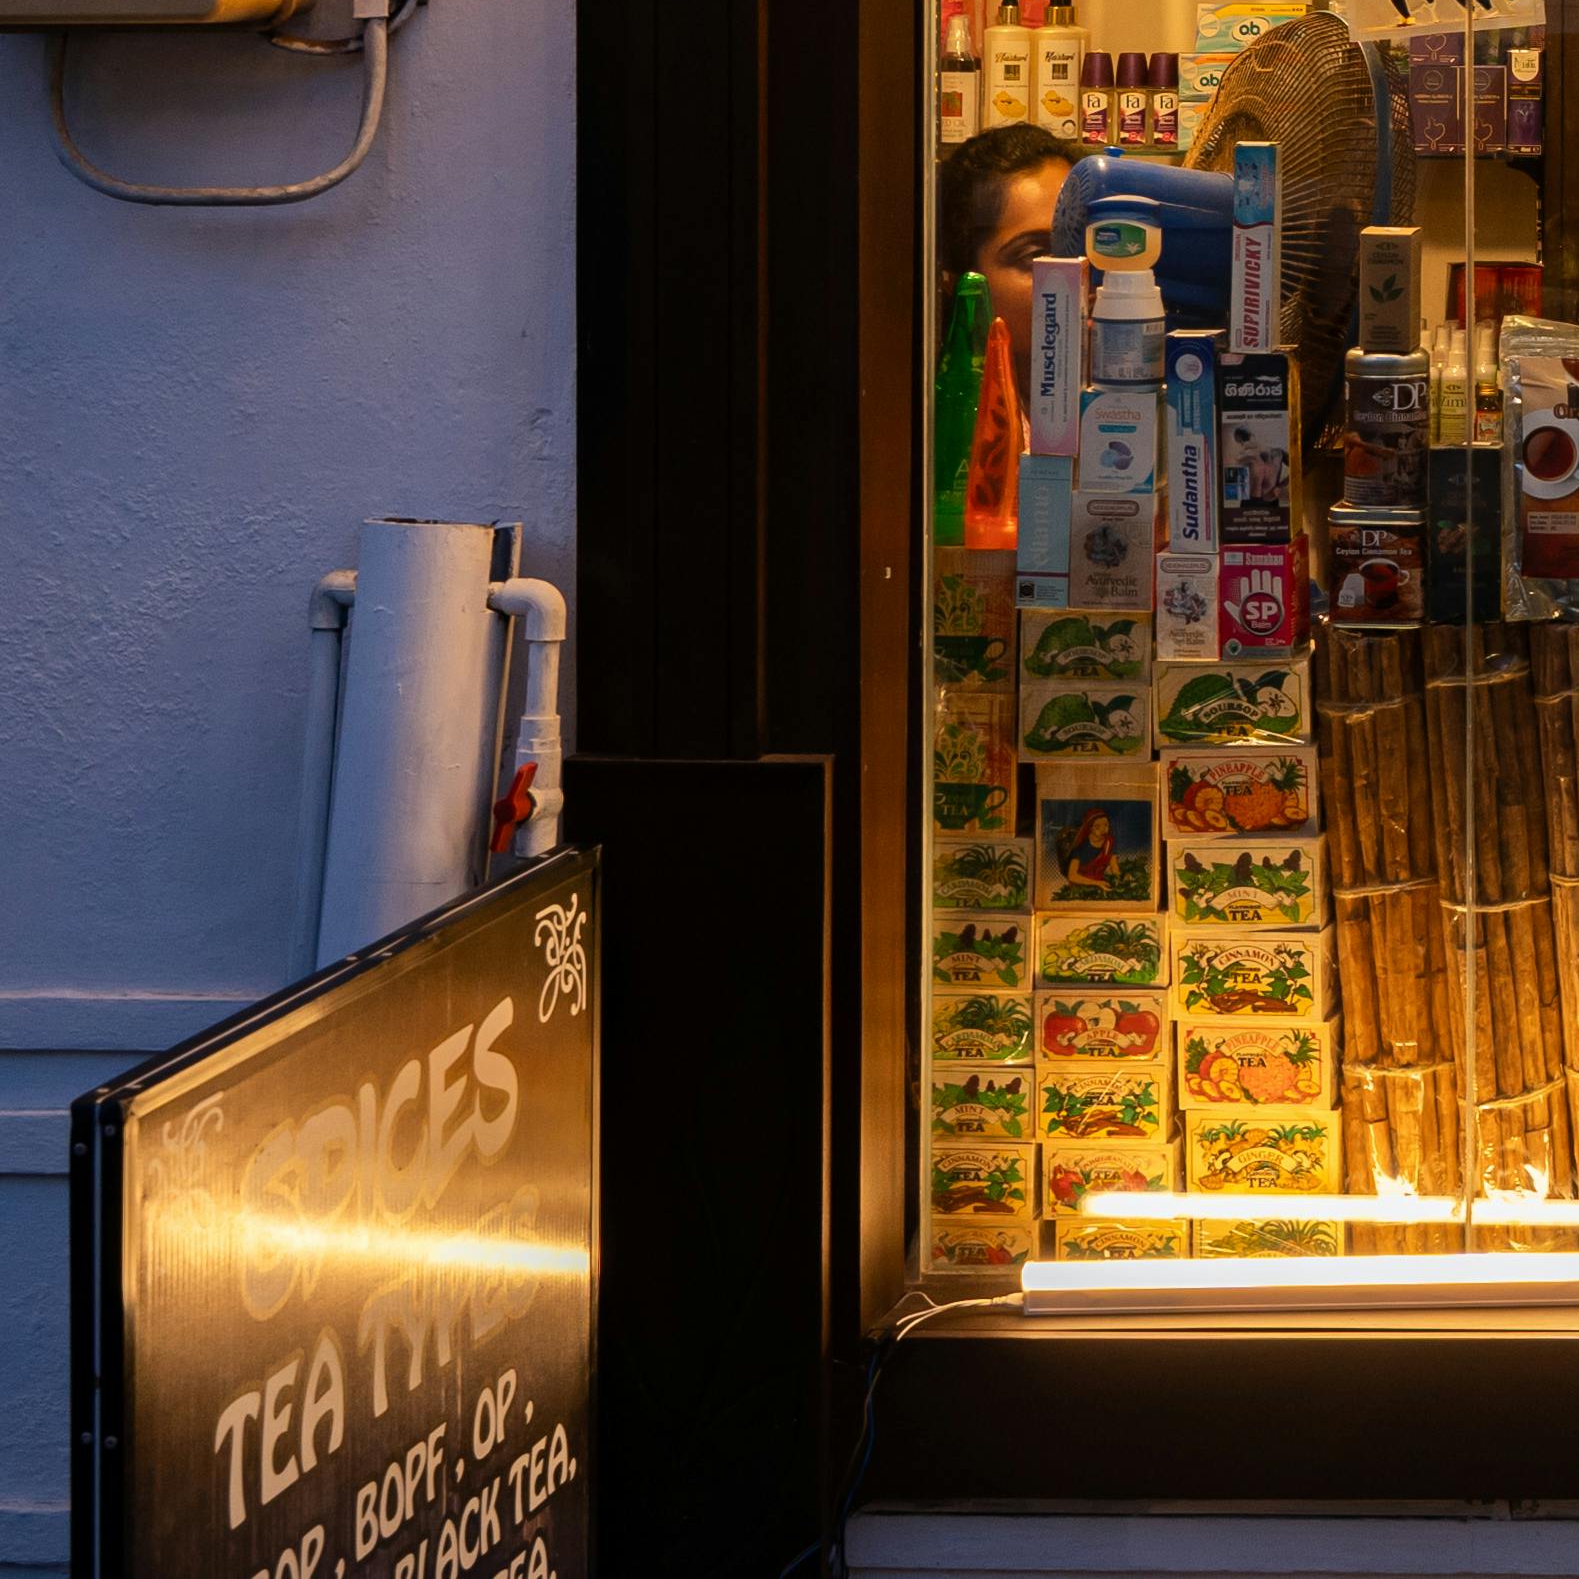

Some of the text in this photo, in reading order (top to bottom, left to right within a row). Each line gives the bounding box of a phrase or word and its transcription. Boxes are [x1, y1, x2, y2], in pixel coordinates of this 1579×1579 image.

[1087, 95, 1101, 109] Fa
[1126, 95, 1140, 109] Fa
[1159, 95, 1173, 109] Fa
[1242, 236, 1262, 348] SUPIRIVICKY
[1040, 292, 1060, 398] Musclegard
[1392, 382, 1427, 411] DP
[1095, 407, 1141, 421] Swastha
[1181, 443, 1200, 541] Sudantha
[1362, 529, 1388, 547] DP
[1111, 586, 1138, 597] Balm
[1246, 601, 1278, 620] SP
[1072, 666, 1099, 677] TEA
[1203, 703, 1258, 720] SOURSOP
[1216, 726, 1248, 737] TEA
[1072, 742, 1099, 753] TEA
[1209, 763, 1264, 783] PINEAPPLE
[1223, 784, 1253, 797] TEA
[940, 804, 968, 815] TEA
[1226, 889, 1259, 901] MINT
[1229, 909, 1263, 922] TEA
[951, 954, 980, 964] MINT
[1217, 949, 1276, 967] CINNAMON
[953, 971, 981, 983] TEA
[1230, 972, 1261, 984] TEA
[1086, 1030, 1119, 1040] APPLE
[1225, 1033, 1280, 1053] PINEAPPLE
[955, 1048, 984, 1059] TEA
[1088, 1046, 1116, 1058] TEA
[1238, 1057, 1267, 1068] TEA
[1087, 1095, 1116, 1106] TEA
[954, 1105, 984, 1115] MINT
[956, 1121, 985, 1133] TEA
[240, 996, 518, 1321] SPICES
[940, 1153, 994, 1171] CINNAMON
[1237, 1153, 1284, 1165] GINGER
[954, 1171, 982, 1182] TEA
[1246, 1176, 1278, 1189] TEA
[214, 1327, 345, 1530] TEA
